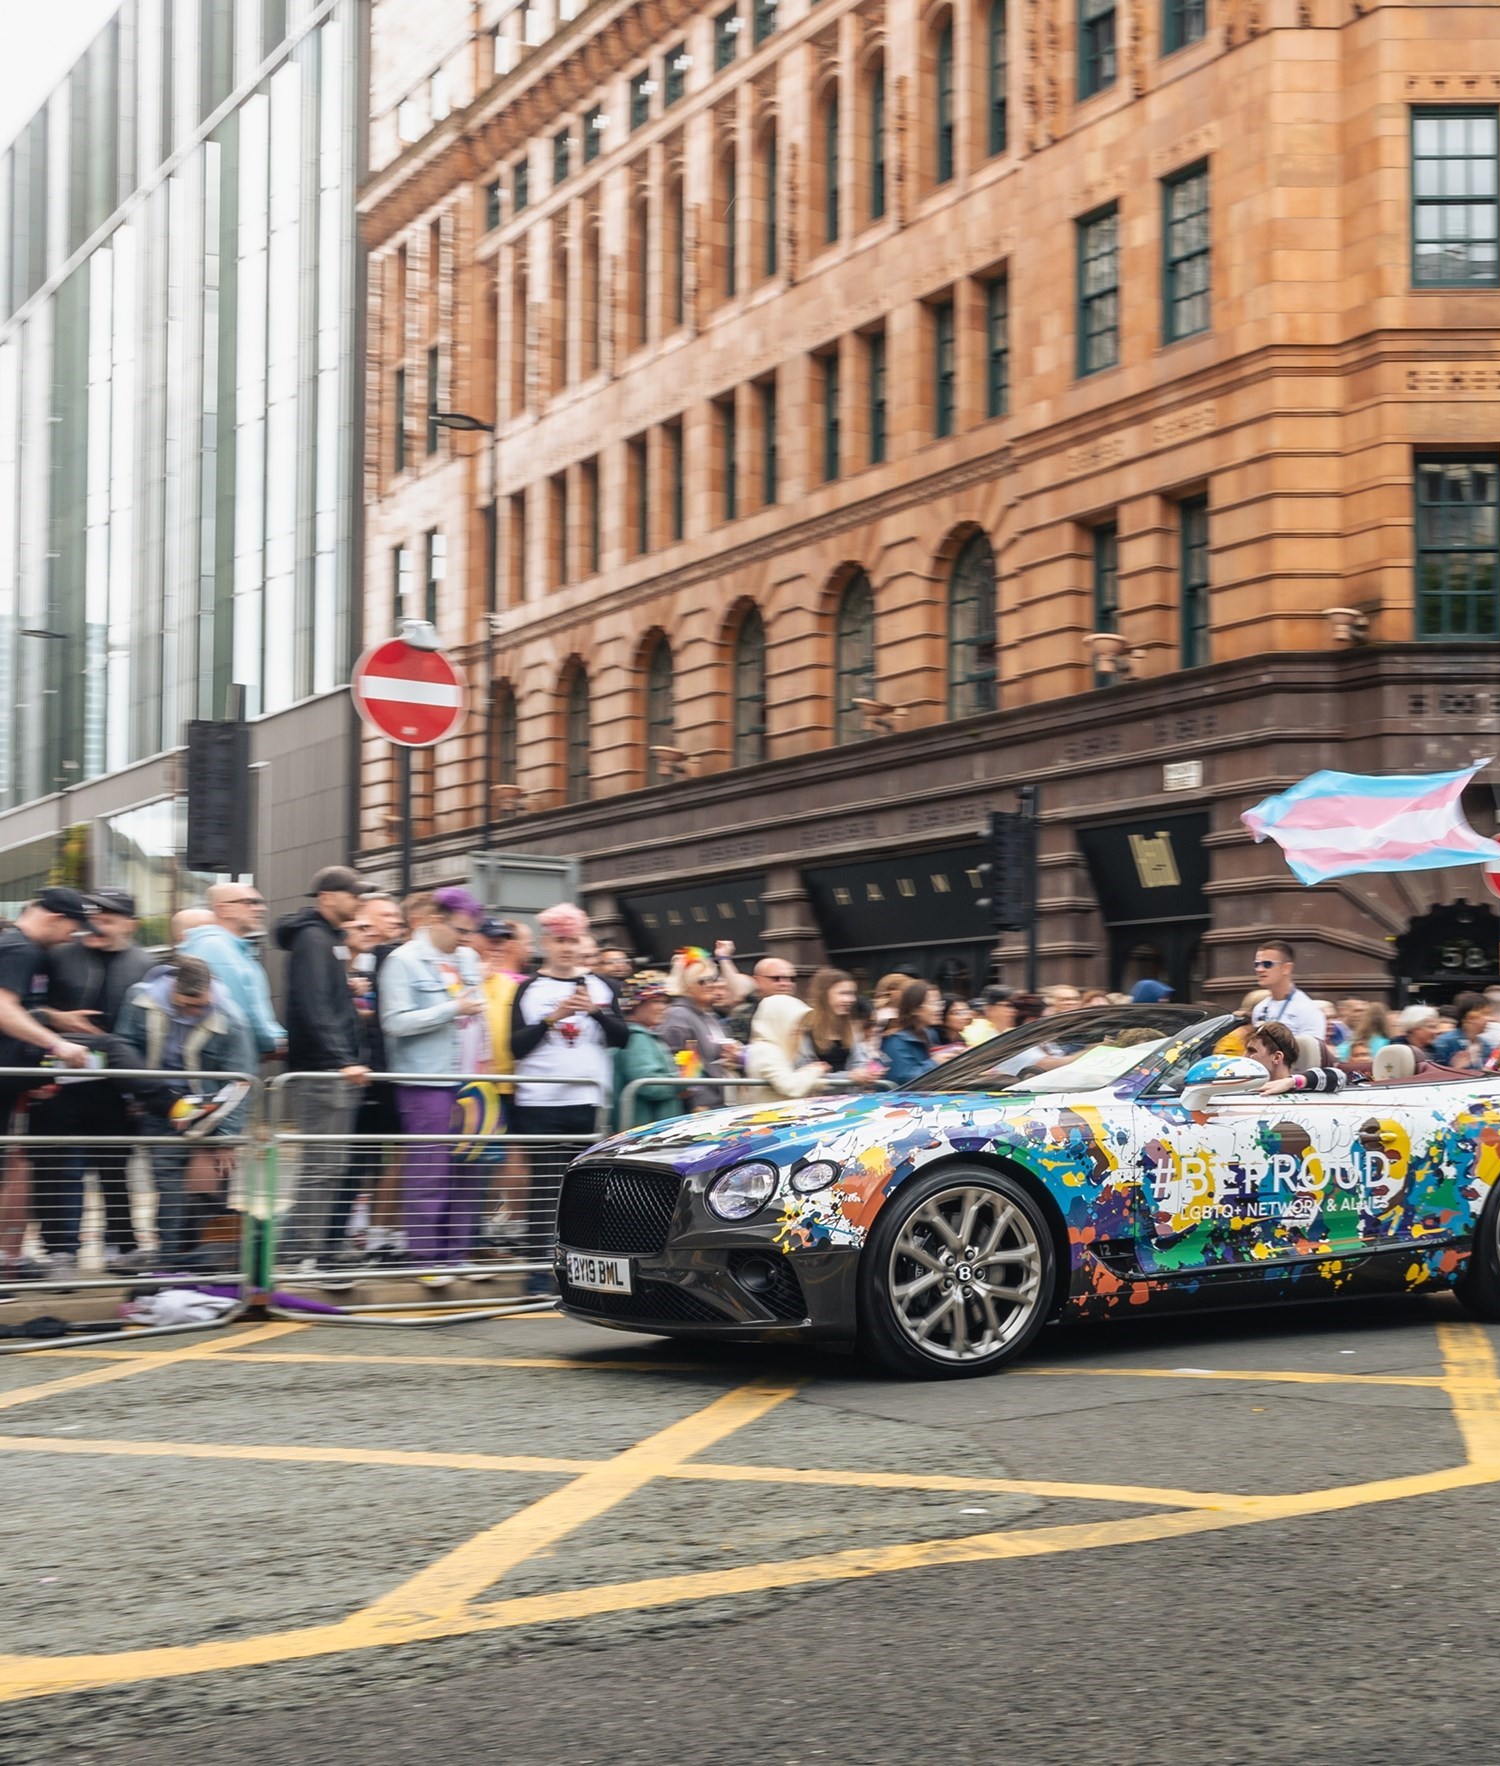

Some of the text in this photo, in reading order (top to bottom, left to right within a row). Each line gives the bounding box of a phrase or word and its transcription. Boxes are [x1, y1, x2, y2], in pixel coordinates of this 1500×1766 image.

[832, 870, 983, 905] HAUNT
[641, 899, 760, 929] HAUNT
[1441, 947, 1486, 968] 58
[1150, 1150, 1389, 1199] #BEPROUD
[1180, 1203, 1242, 1220] LGBTQ+
[1246, 1199, 1323, 1217] NETWORK
[1326, 1198, 1337, 1212] &
[598, 1261, 624, 1286] BML
